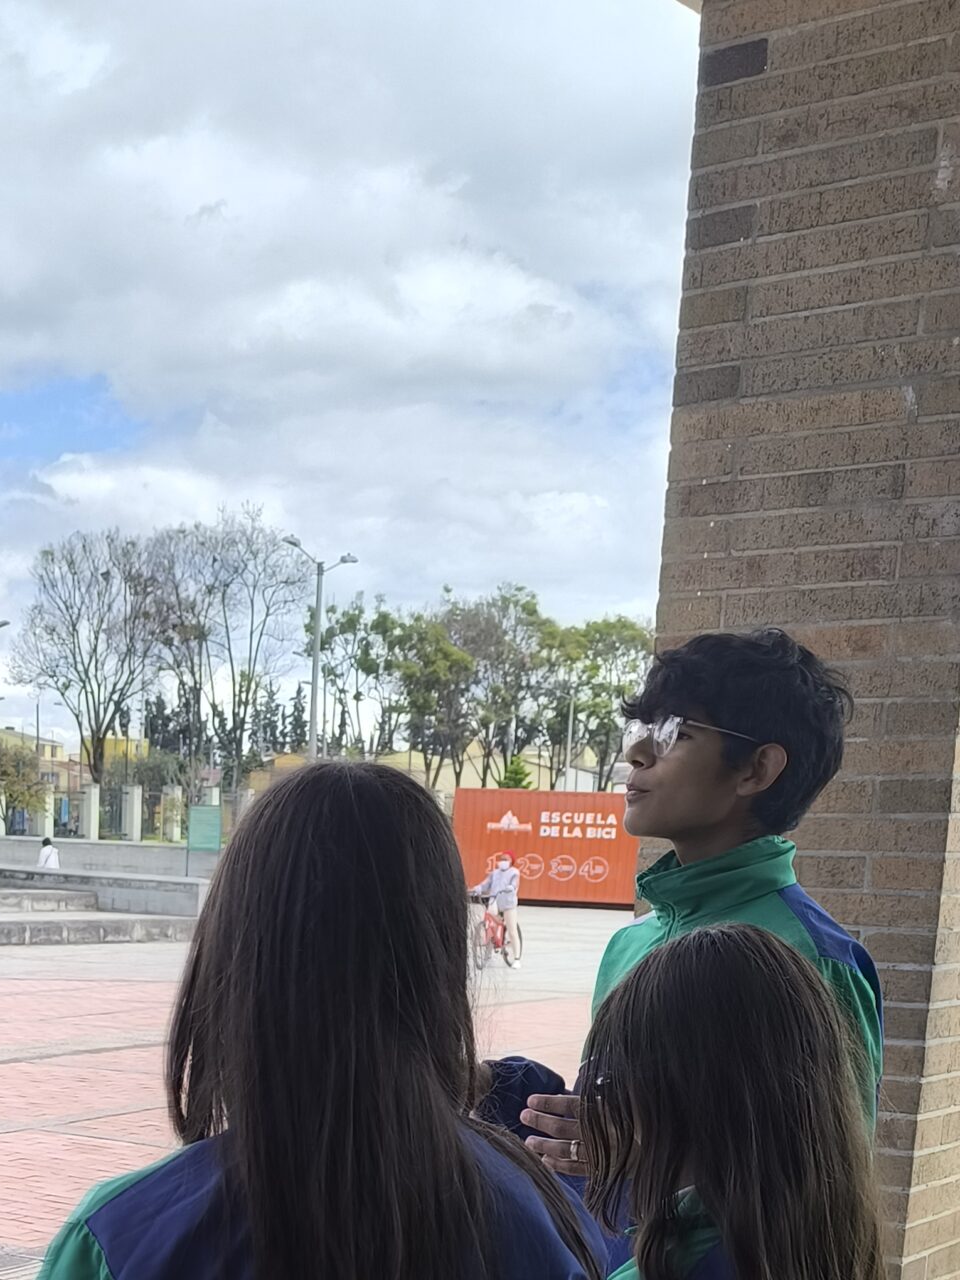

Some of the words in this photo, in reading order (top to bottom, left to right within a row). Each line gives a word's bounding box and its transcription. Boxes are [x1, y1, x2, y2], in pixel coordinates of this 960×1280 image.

[540, 811, 617, 825] ESCUELA
[539, 825, 560, 837] DE
[562, 826, 583, 838] LA
[586, 827, 617, 839] BICI
[516, 857, 530, 875] 2
[548, 858, 562, 877] 3
[579, 860, 594, 876] 4
